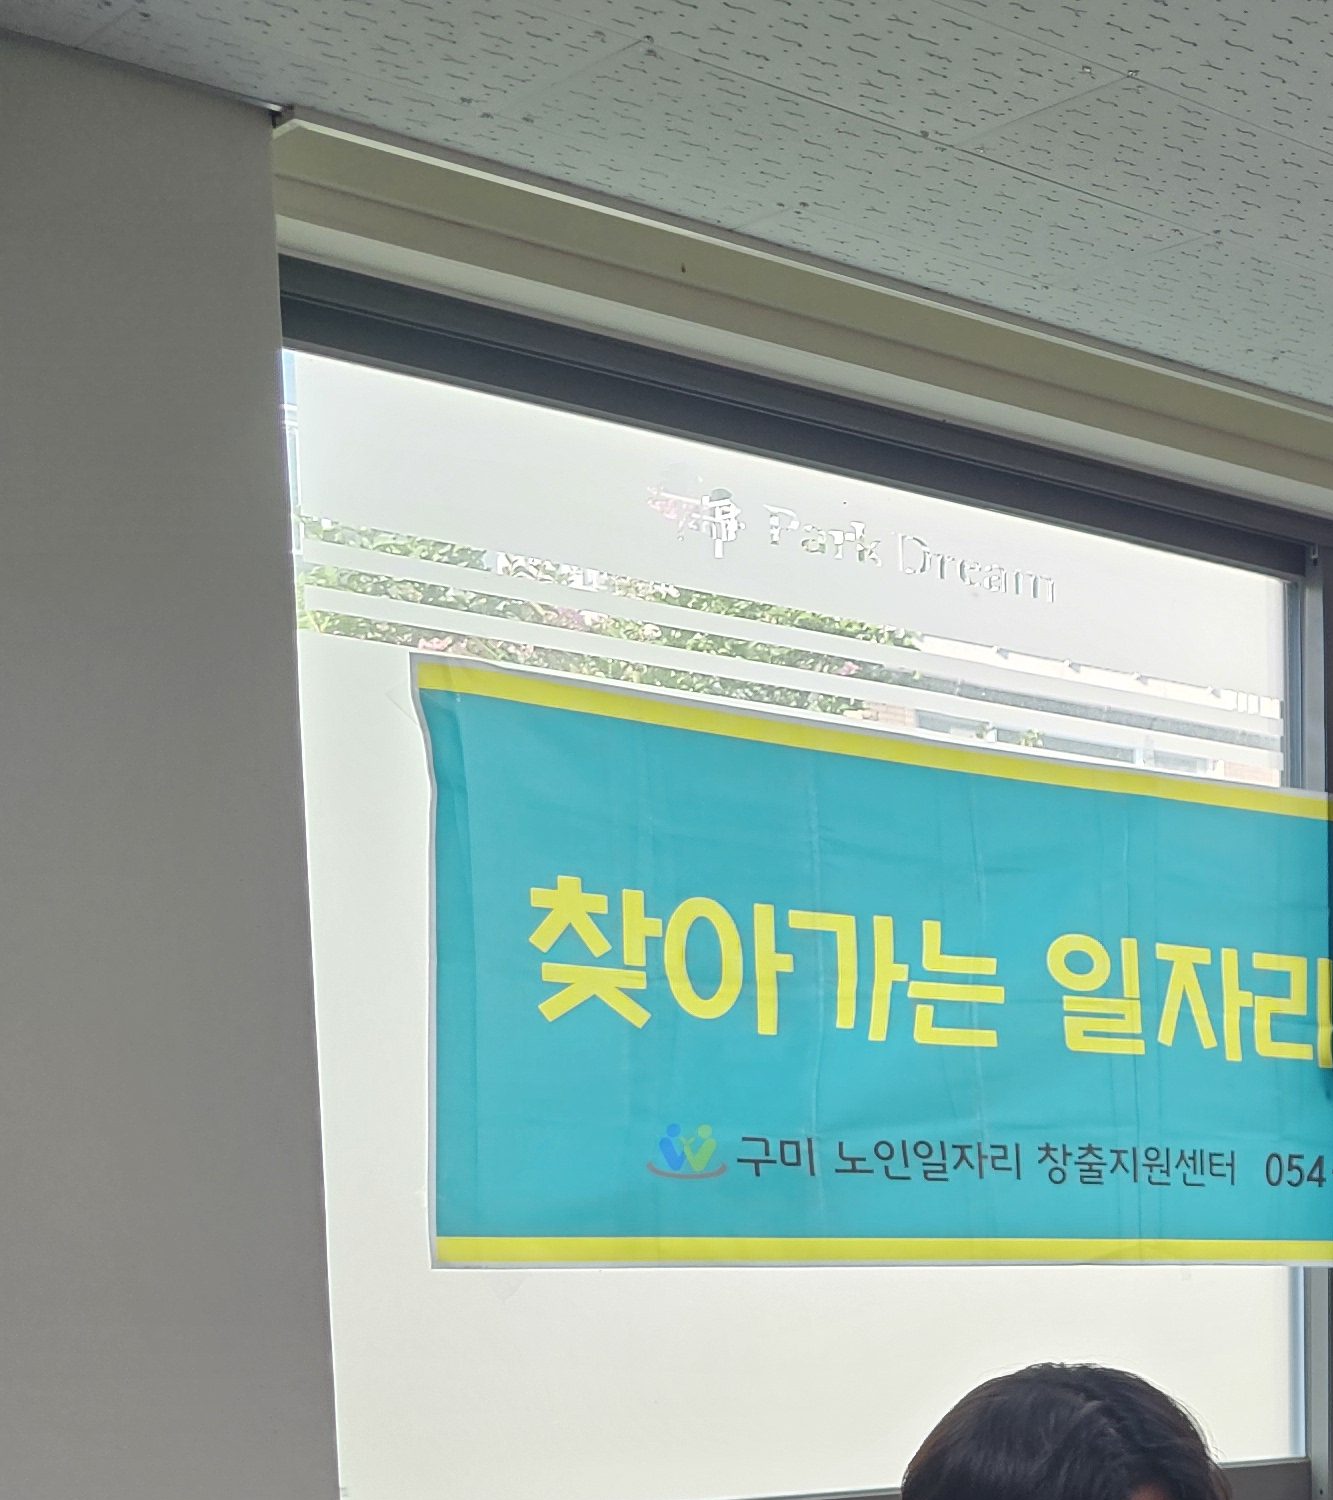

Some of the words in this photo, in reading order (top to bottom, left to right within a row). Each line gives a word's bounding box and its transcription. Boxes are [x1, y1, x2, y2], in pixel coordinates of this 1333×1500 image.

[763, 503, 883, 568] Park
[893, 531, 1056, 604] Dream
[528, 874, 1005, 1049] 찾아가는
[1046, 933, 1333, 1069] 일자리
[736, 1136, 817, 1178] 구미
[834, 1139, 1023, 1183] 노인일자리
[1036, 1141, 1238, 1189] 창출지원센터
